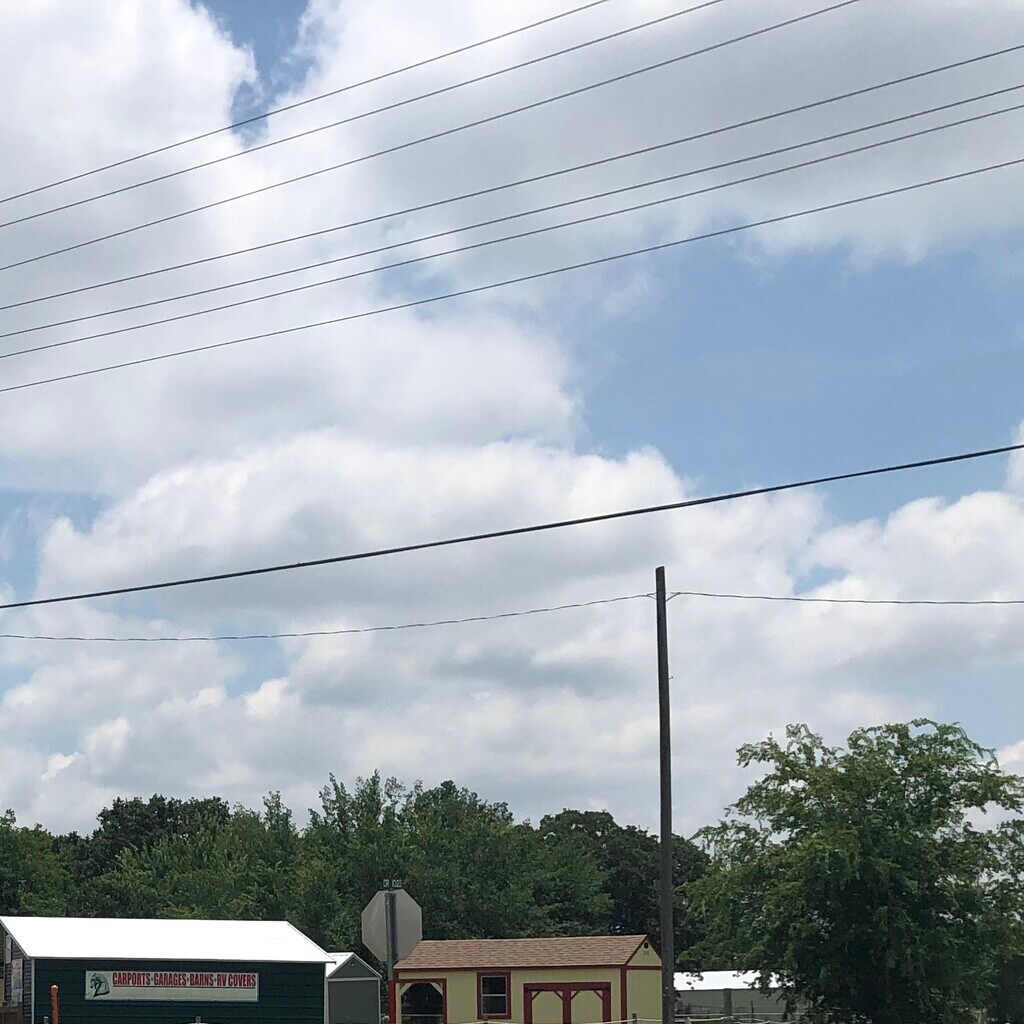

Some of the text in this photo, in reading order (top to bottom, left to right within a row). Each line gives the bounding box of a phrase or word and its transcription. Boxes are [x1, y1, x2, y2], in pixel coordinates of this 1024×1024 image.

[112, 972, 256, 987] CARPORTS GARAGES BARNS RV COVERS
